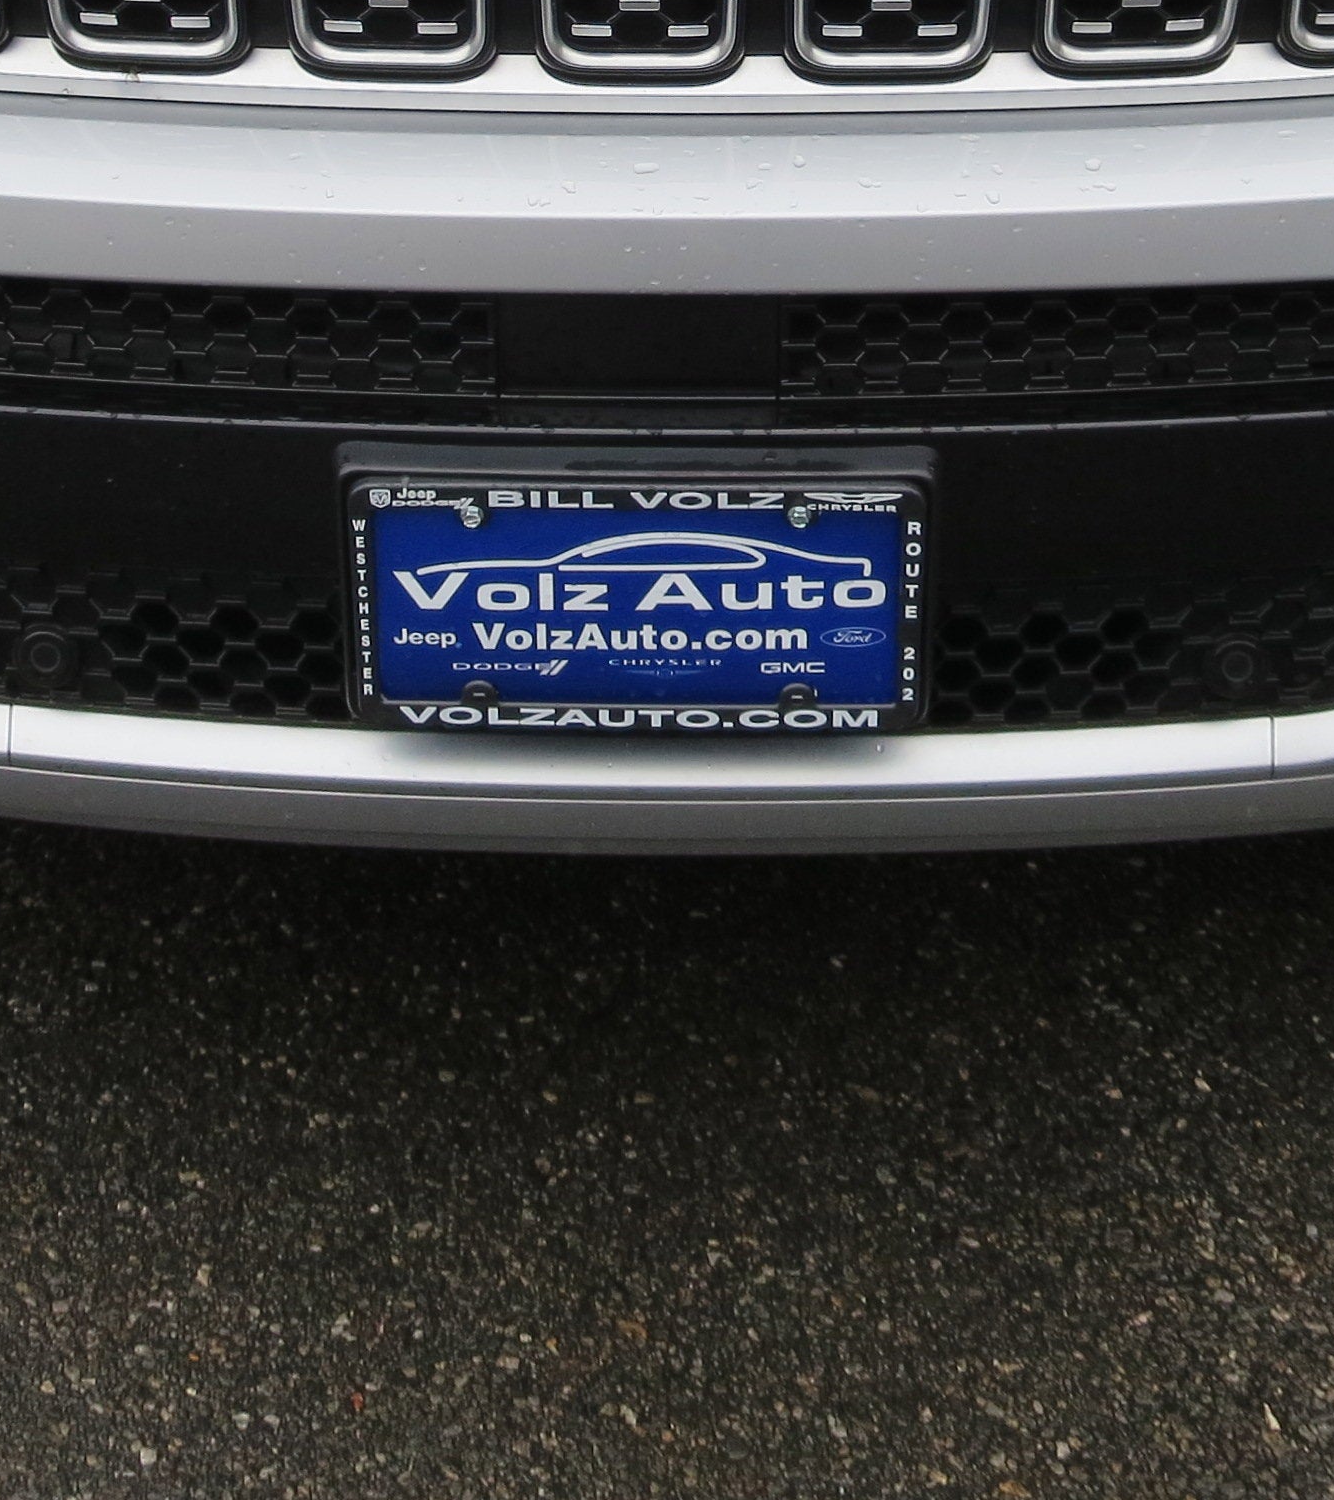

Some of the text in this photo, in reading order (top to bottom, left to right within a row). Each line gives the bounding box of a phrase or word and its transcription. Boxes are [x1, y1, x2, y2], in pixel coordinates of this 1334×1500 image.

[396, 487, 436, 501] Jeep
[488, 490, 785, 510] BILL VOLZ
[807, 503, 897, 513] CHRYSLER
[393, 570, 887, 611] Volz Auto
[352, 519, 373, 696] WESTCHESTER
[902, 521, 921, 701] ROUTE 202
[393, 628, 457, 648] Jeep
[472, 623, 808, 651] VolzAuto.com
[832, 629, 873, 644] Ford
[452, 663, 545, 671] DODGE
[608, 658, 722, 667] CHRYSLER
[760, 662, 826, 674] GMC
[399, 705, 878, 728] VOLZAUTO.COM
